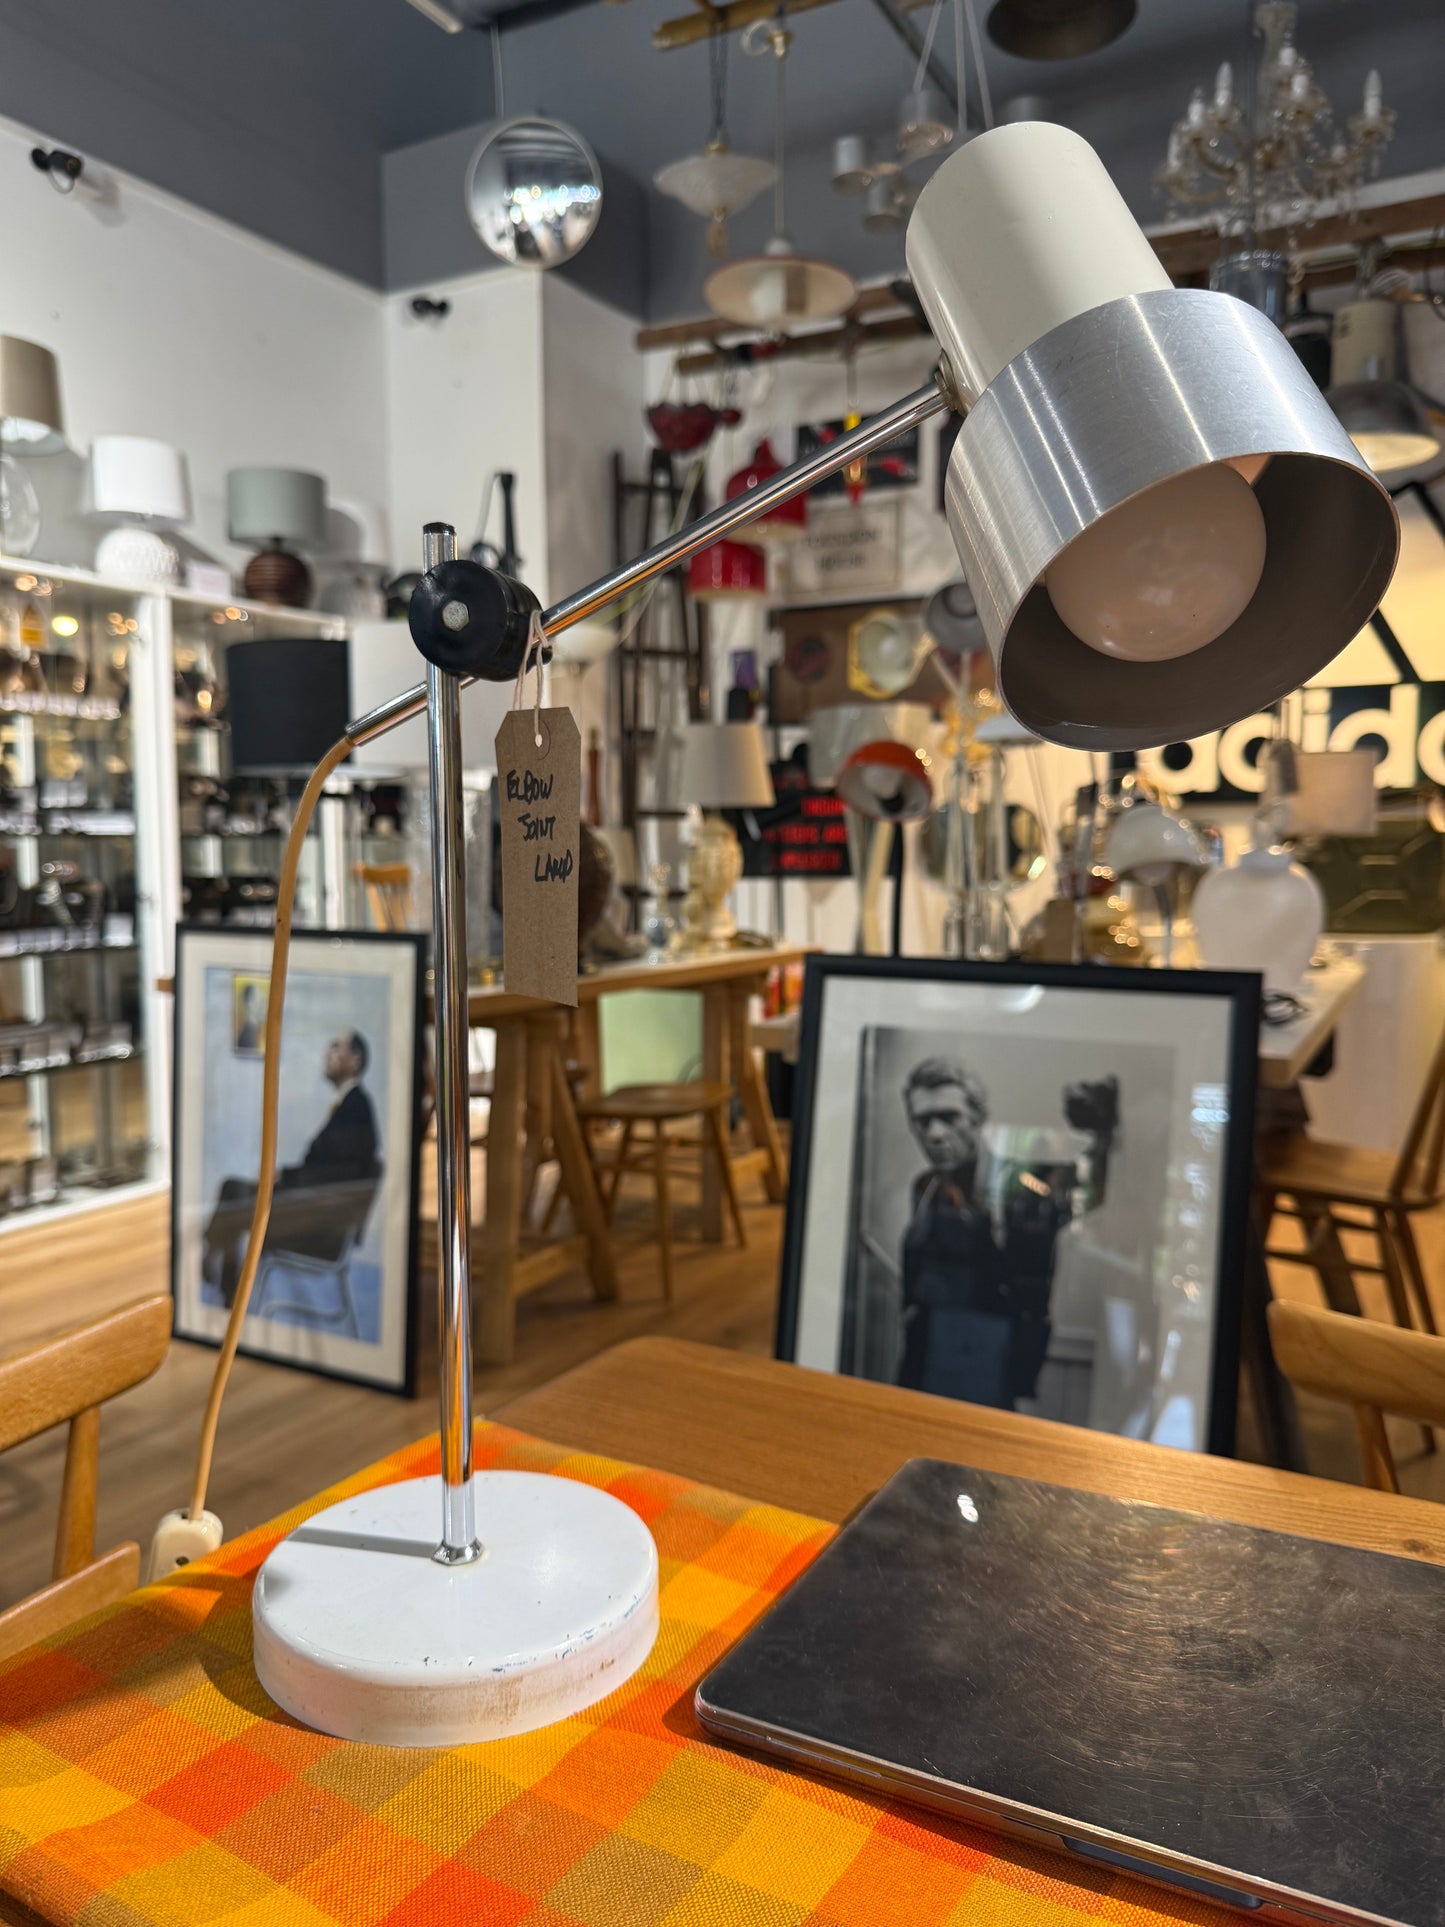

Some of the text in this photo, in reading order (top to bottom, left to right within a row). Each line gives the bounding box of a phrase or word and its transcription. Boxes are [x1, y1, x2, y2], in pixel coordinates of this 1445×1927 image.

[507, 769, 553, 805] ELBOW
[518, 813, 556, 841] JOINT
[535, 849, 573, 883] LAMP
